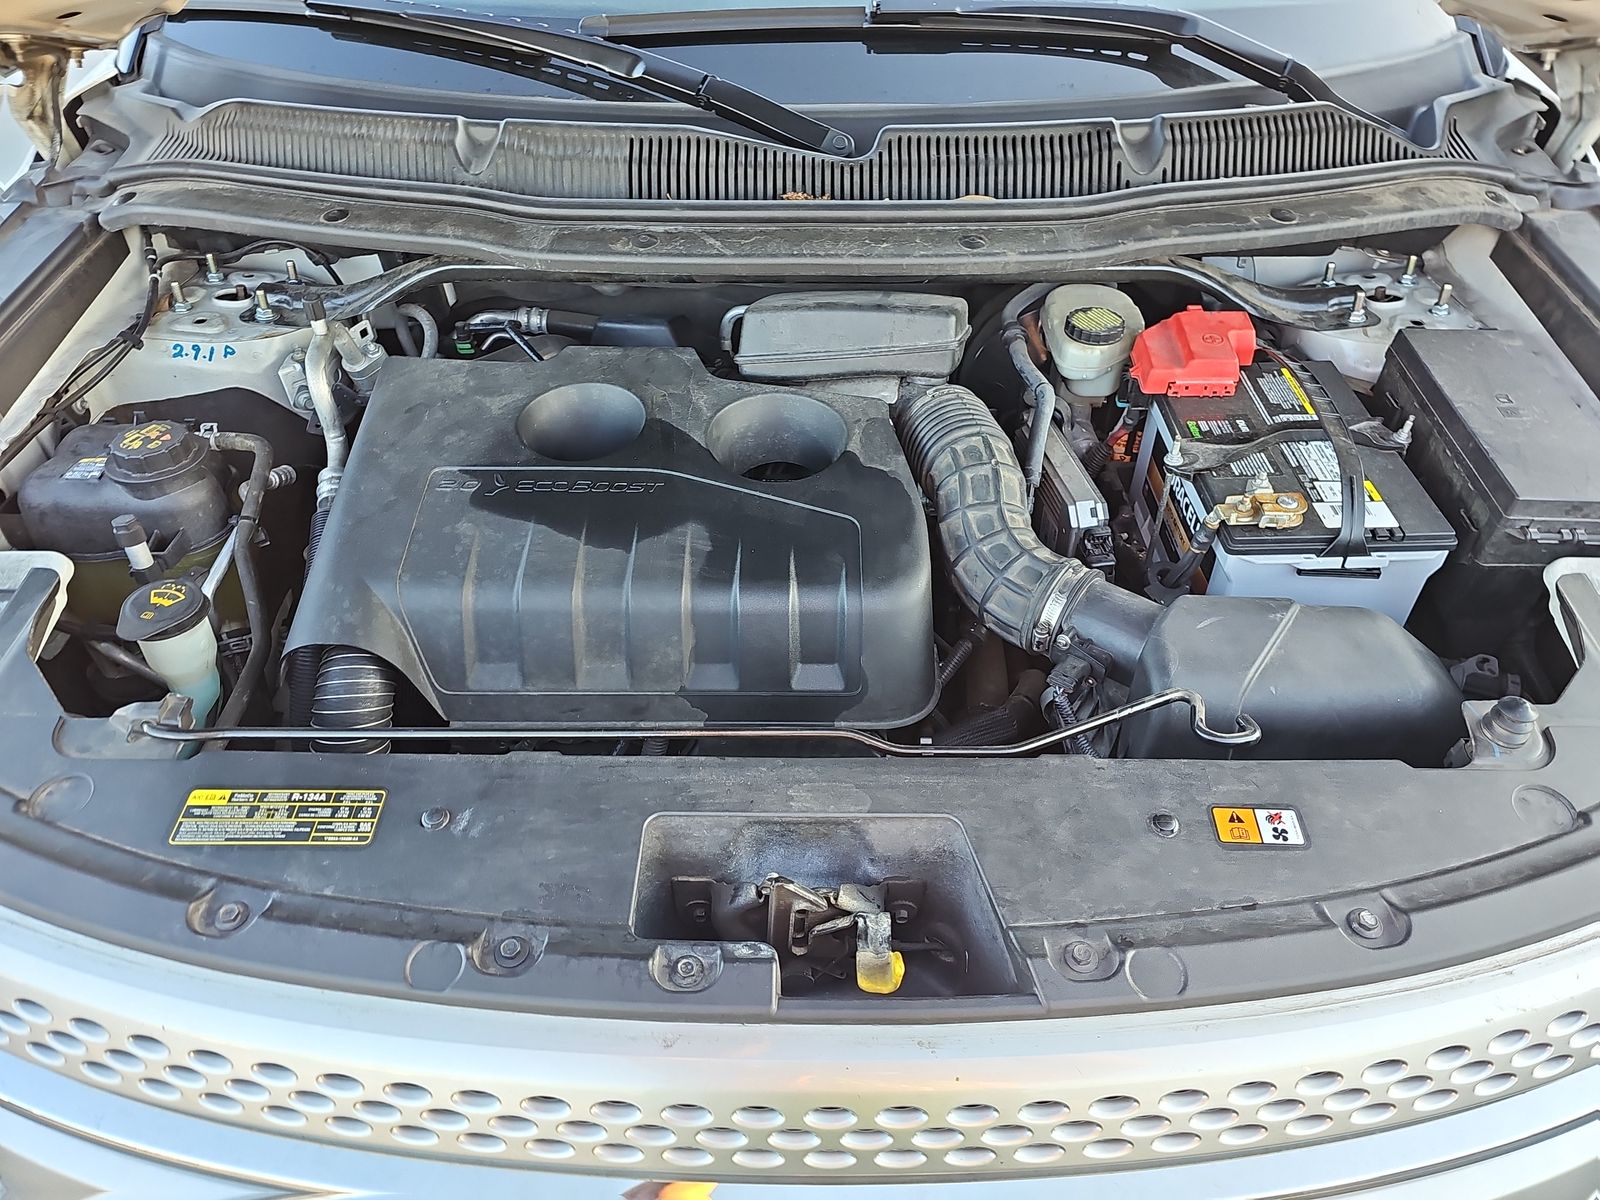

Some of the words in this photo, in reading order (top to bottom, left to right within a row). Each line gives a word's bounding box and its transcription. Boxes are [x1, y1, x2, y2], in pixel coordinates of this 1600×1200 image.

[514, 479, 665, 493] ECOBOOST
[1171, 475, 1202, 535] RACEL
[291, 792, 327, 802] R-134A
